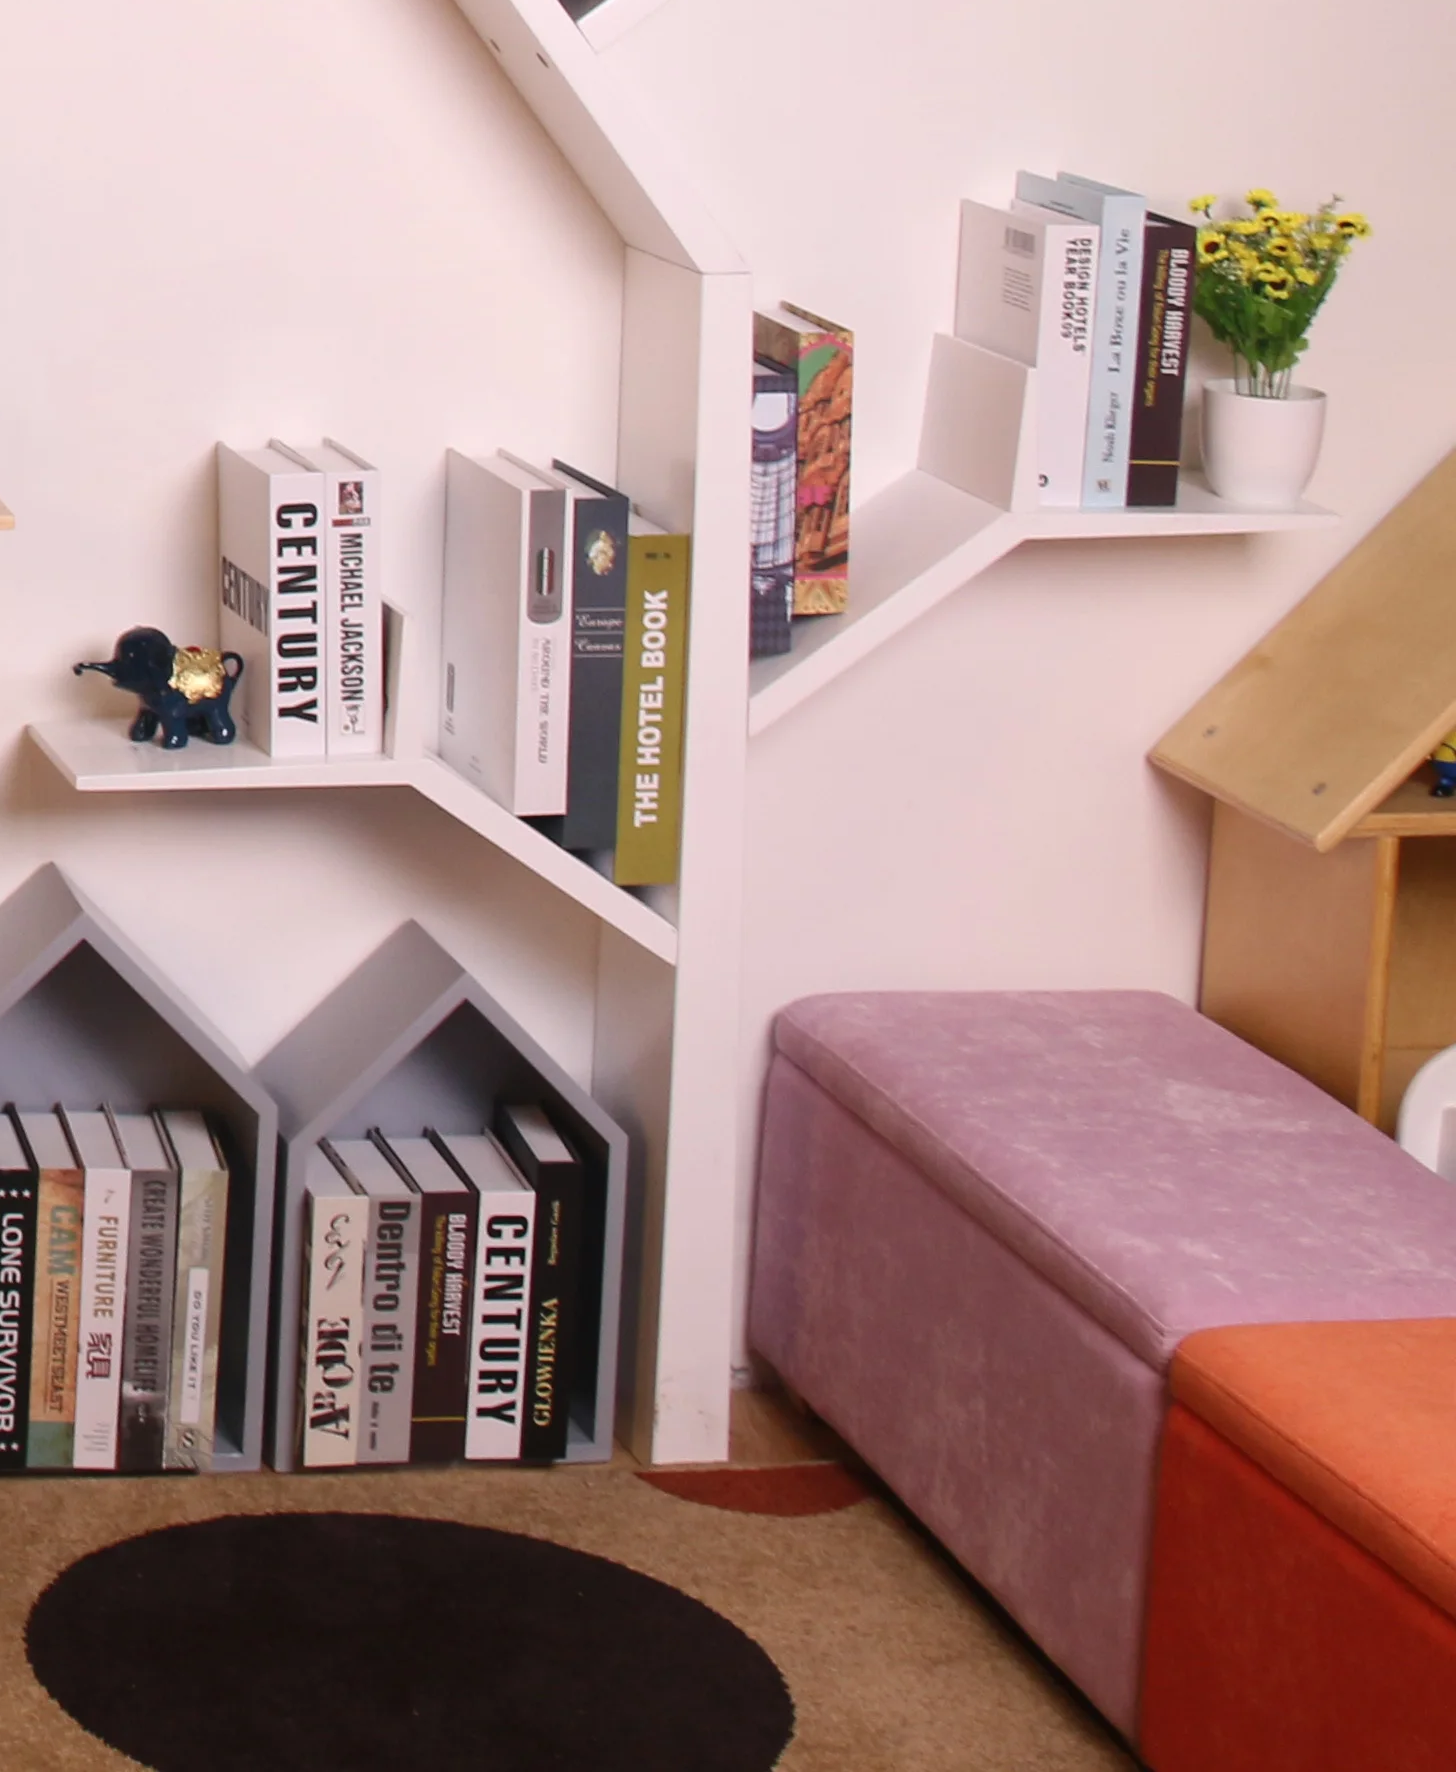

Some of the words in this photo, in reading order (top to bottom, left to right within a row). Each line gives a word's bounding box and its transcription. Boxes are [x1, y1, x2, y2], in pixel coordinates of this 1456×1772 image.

[1065, 239, 1078, 275] YEAR
[1078, 238, 1092, 290] DESIGN
[1115, 260, 1127, 276] la
[1116, 229, 1131, 256] Vie
[1115, 280, 1127, 301] ou
[1167, 248, 1190, 307] BLOODY
[1073, 297, 1088, 352] HOTELS
[1109, 305, 1125, 337] Boxe
[1160, 310, 1185, 377] HARVEST
[1107, 353, 1121, 373] La
[338, 532, 363, 613] MICHAEL
[276, 502, 319, 724] CENTURY
[641, 589, 669, 667] BOOK
[339, 618, 365, 702] JACKSON
[637, 676, 666, 765] HOTEL
[634, 773, 659, 828] THE
[143, 1180, 167, 1227] CREATE
[0, 1212, 24, 1283] LONE
[47, 1205, 79, 1275] CAM
[92, 1215, 120, 1319] FURNITURE
[372, 1201, 411, 1313] Dentro
[446, 1213, 468, 1269] BLOODY
[136, 1231, 165, 1322] WONDERFUL
[193, 1291, 202, 1310] DO
[442, 1273, 464, 1335] HARVEST
[49, 1279, 69, 1413] WESTMEETSEAST
[191, 1314, 201, 1342] YOU
[370, 1322, 405, 1352] di
[476, 1214, 529, 1427] CENTURY
[134, 1325, 160, 1393] HOMELIFE
[187, 1379, 197, 1390] IT
[189, 1345, 199, 1377] LIKE
[368, 1364, 400, 1395] te
